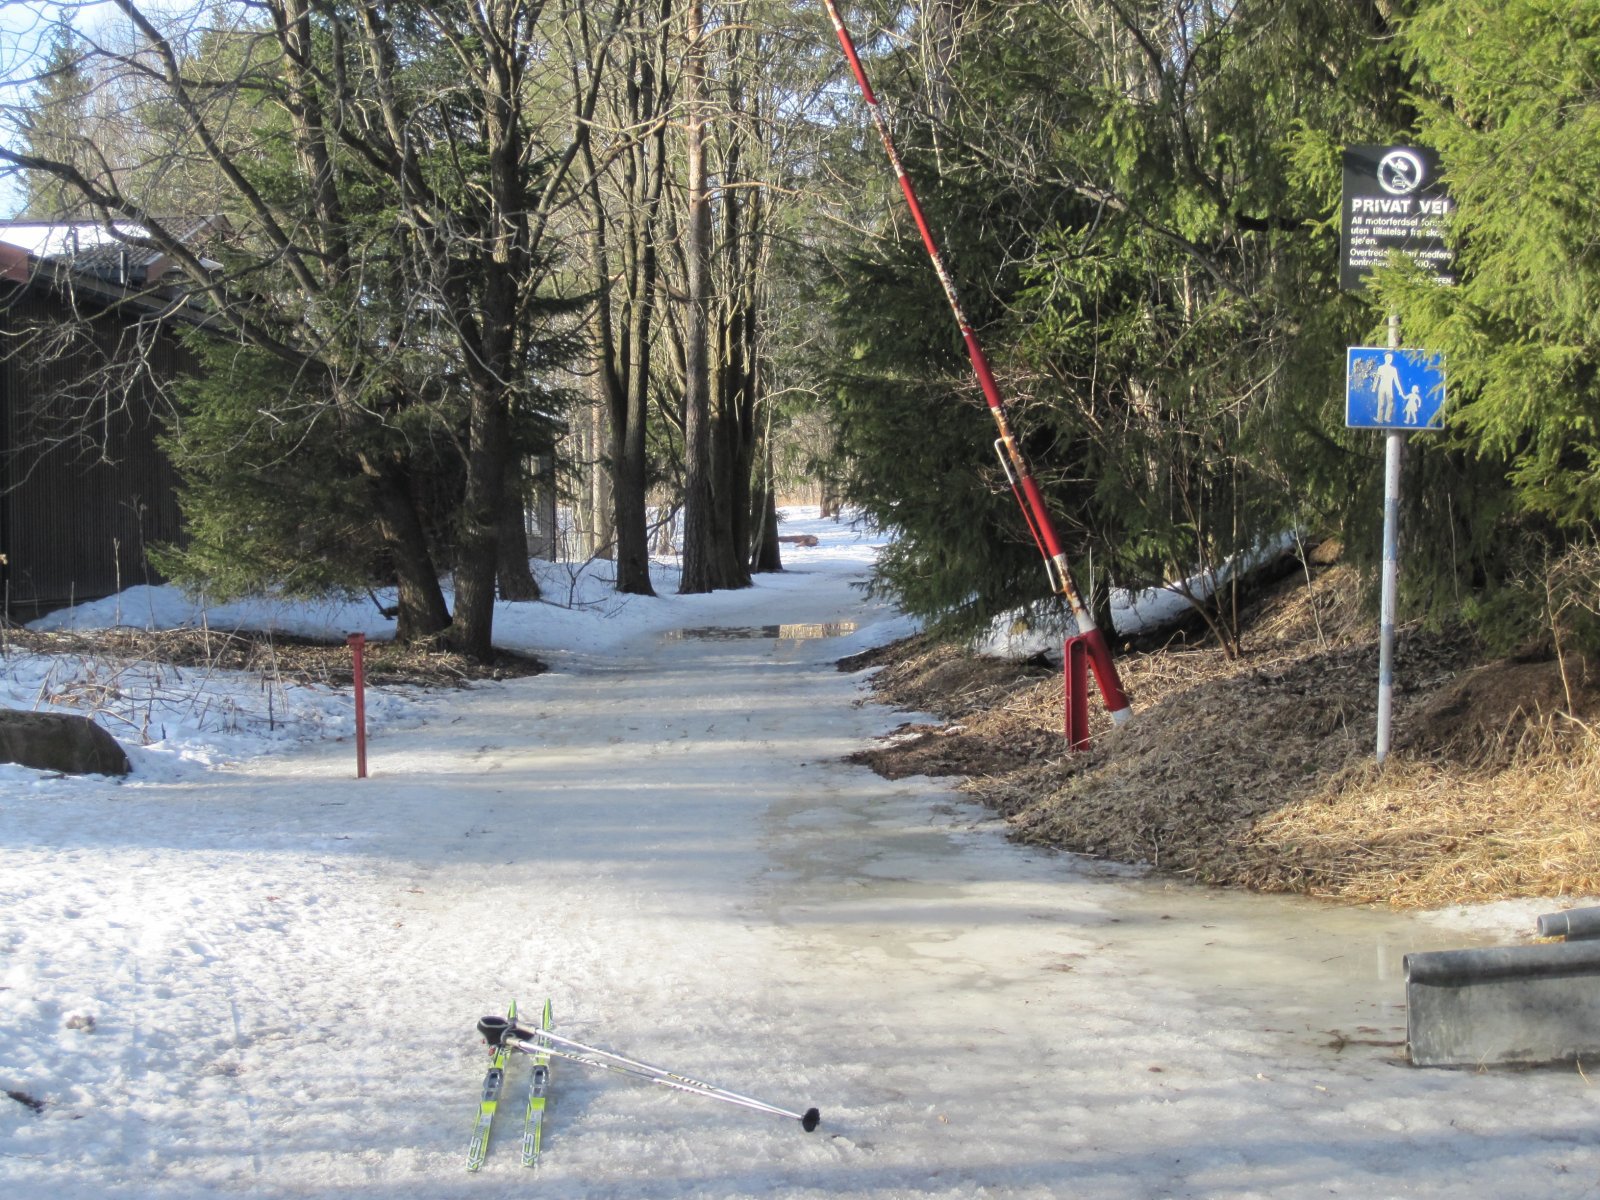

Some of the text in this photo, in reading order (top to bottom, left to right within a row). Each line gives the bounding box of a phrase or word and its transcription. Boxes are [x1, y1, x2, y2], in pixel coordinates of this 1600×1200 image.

[1352, 198, 1449, 214] PRIVAT VEI
[1351, 216, 1363, 225] All
[1365, 217, 1418, 226] motorferdsel
[1350, 226, 1370, 235] uten
[1373, 227, 1407, 236] tillatelse
[1419, 250, 1453, 260] medføre
